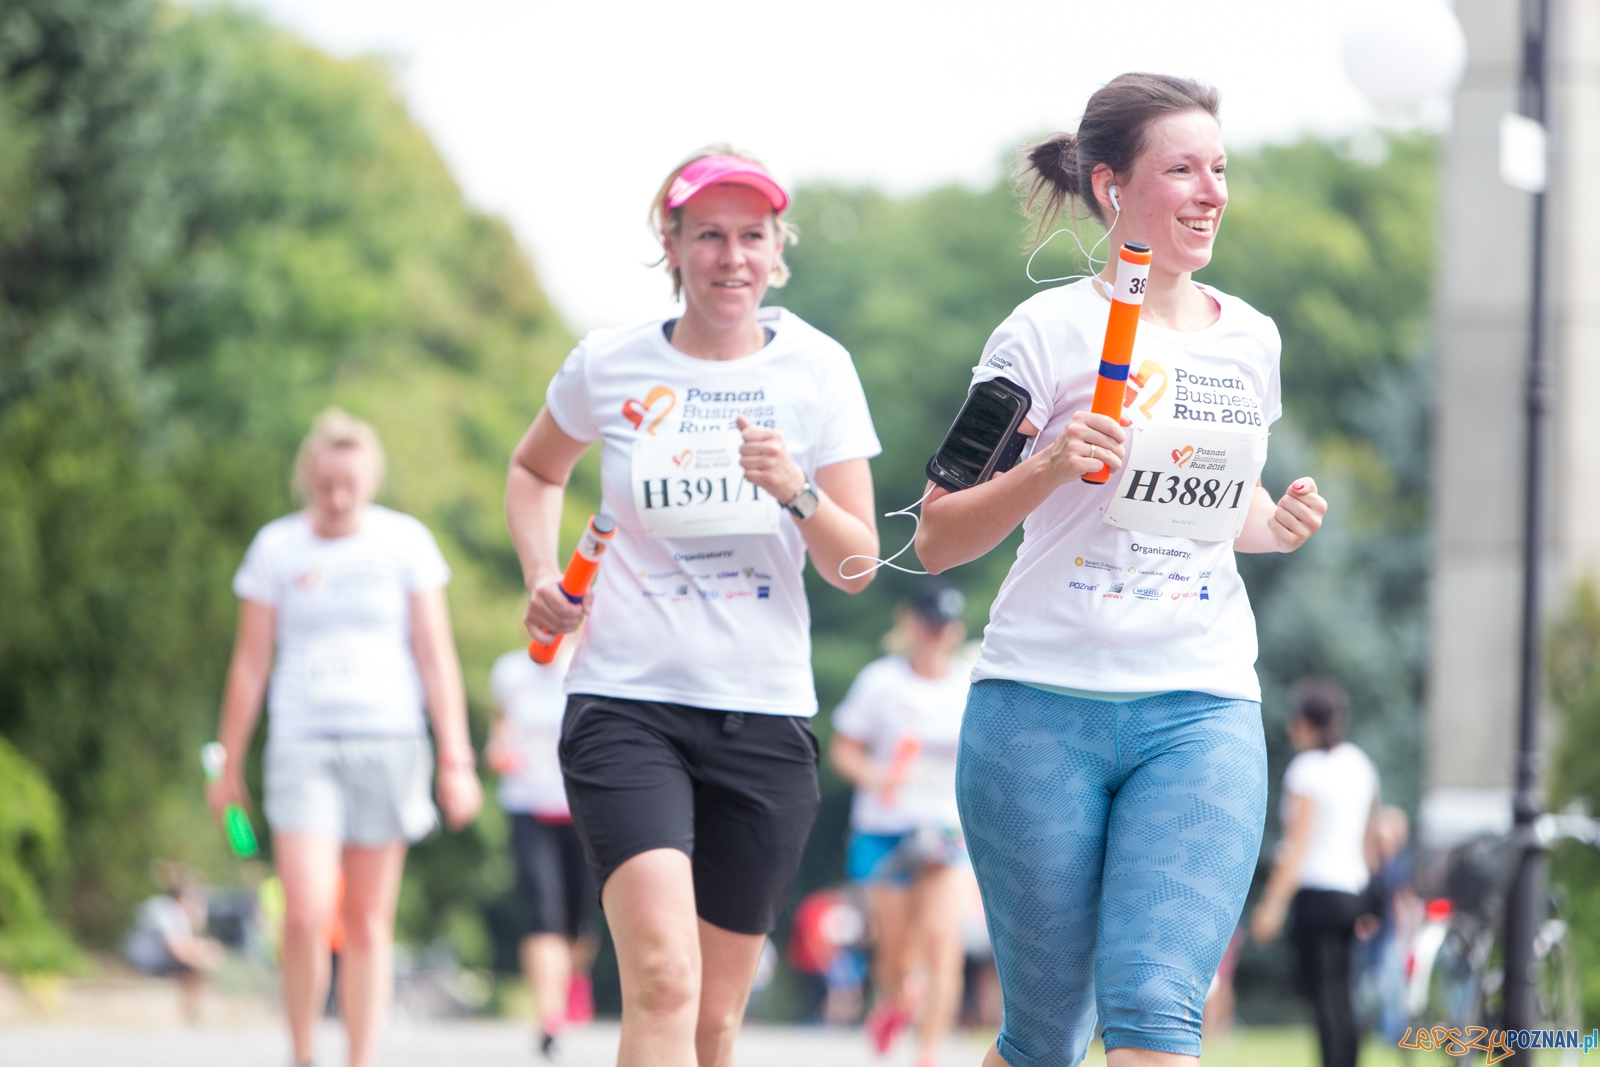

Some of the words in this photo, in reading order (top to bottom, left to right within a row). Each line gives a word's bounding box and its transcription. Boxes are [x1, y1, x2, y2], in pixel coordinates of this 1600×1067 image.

[1174, 367, 1245, 391] Poznań
[686, 386, 765, 403] Poznań
[1174, 385, 1259, 409] Business
[682, 404, 775, 419] Business
[1172, 403, 1217, 423] Run
[1221, 408, 1262, 427] 2016
[1193, 454, 1228, 464] Business
[1196, 447, 1226, 456] Poznań
[1189, 461, 1206, 470] Run
[1206, 463, 1226, 471] 2016
[641, 475, 760, 510] H391/1
[1121, 469, 1246, 510] H388/1
[1131, 543, 1192, 560] Organizatorzy:
[1168, 571, 1190, 582] ciber
